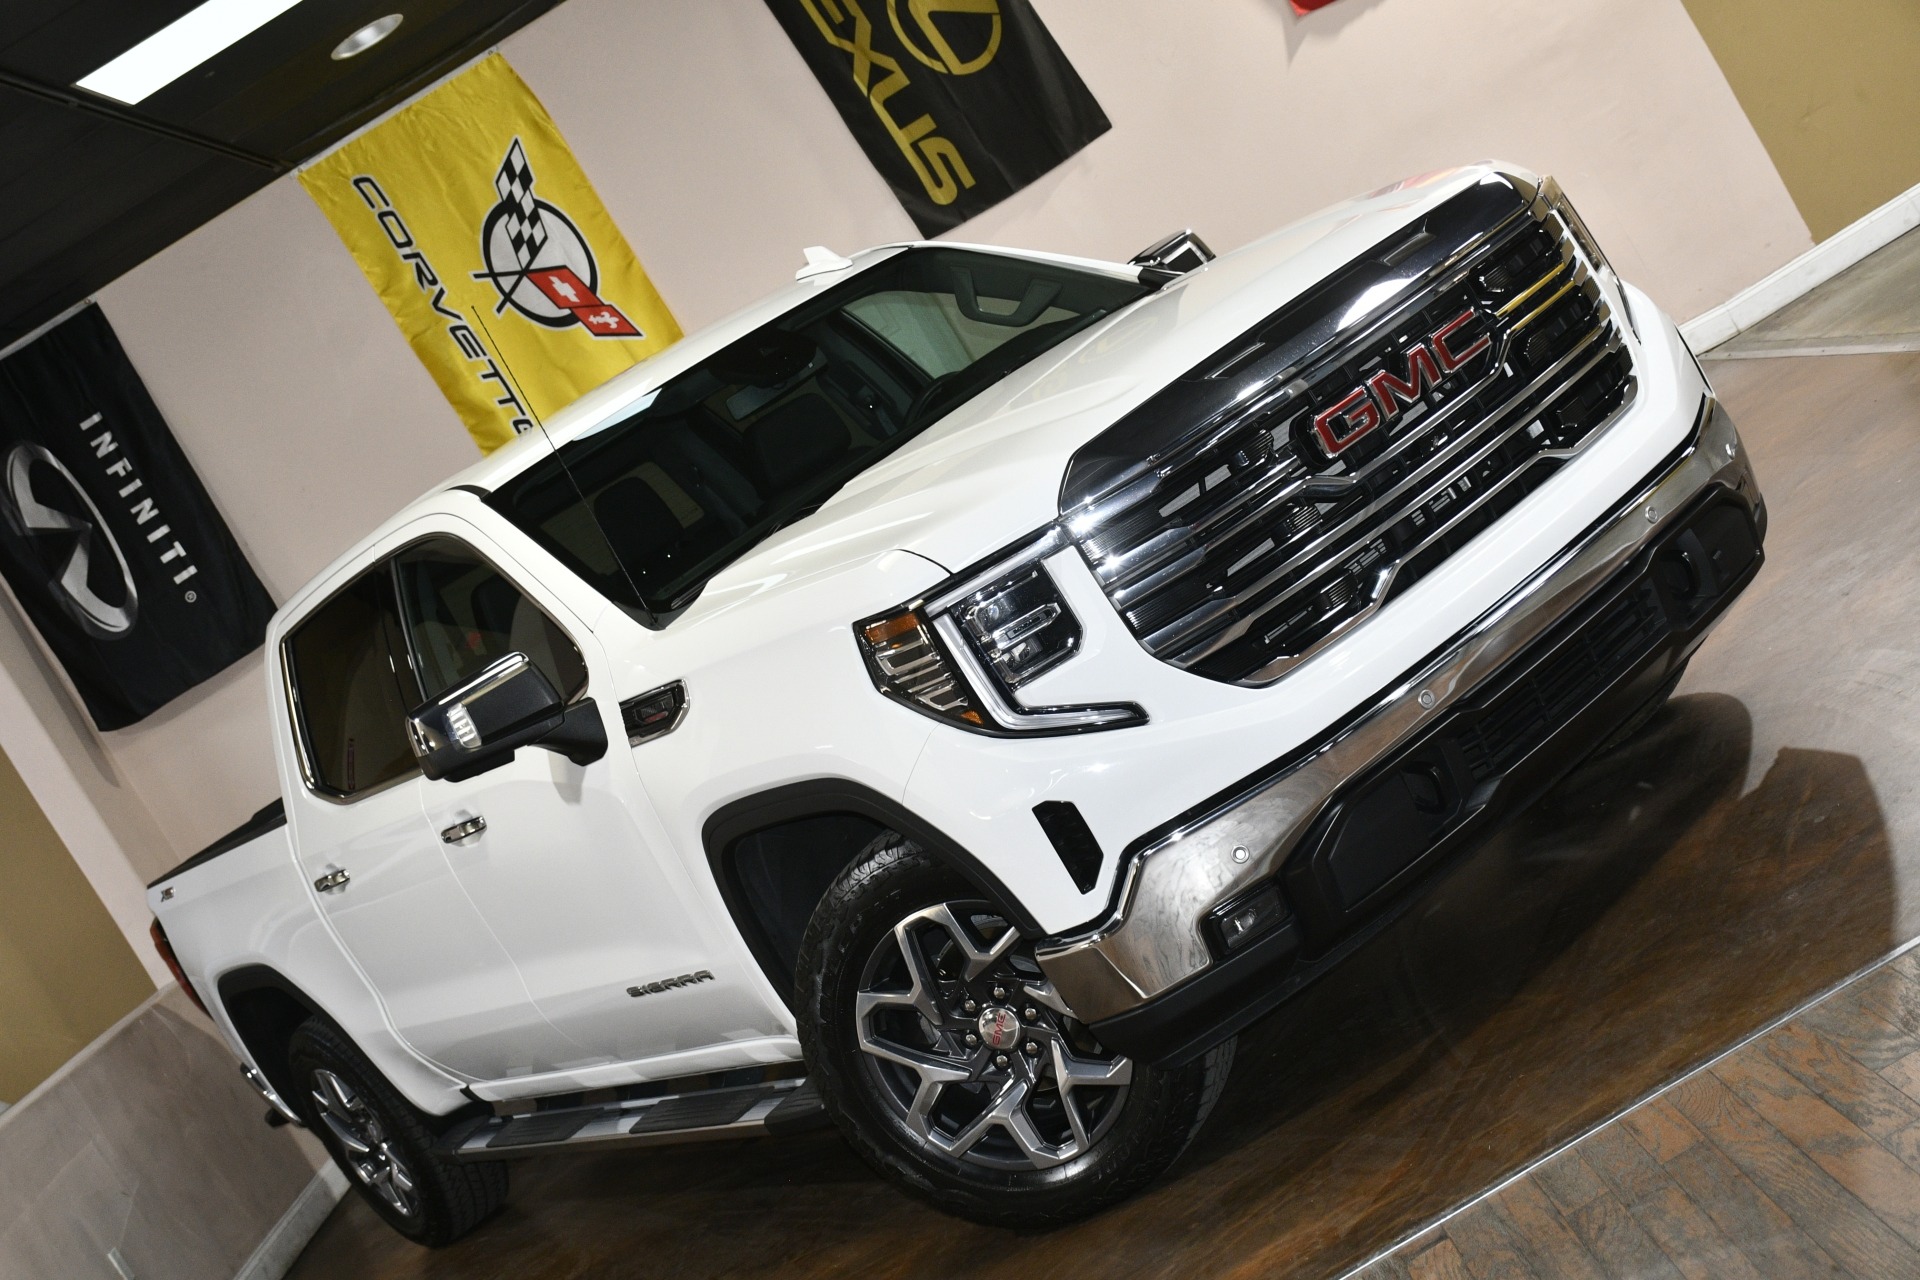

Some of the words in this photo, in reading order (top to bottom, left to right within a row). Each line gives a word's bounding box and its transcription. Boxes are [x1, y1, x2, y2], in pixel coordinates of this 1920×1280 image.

[1309, 306, 1492, 459] GMC
[79, 411, 198, 585] INFINITI
[626, 969, 715, 998] SIERRA
[992, 1011, 1006, 1046] GMC
